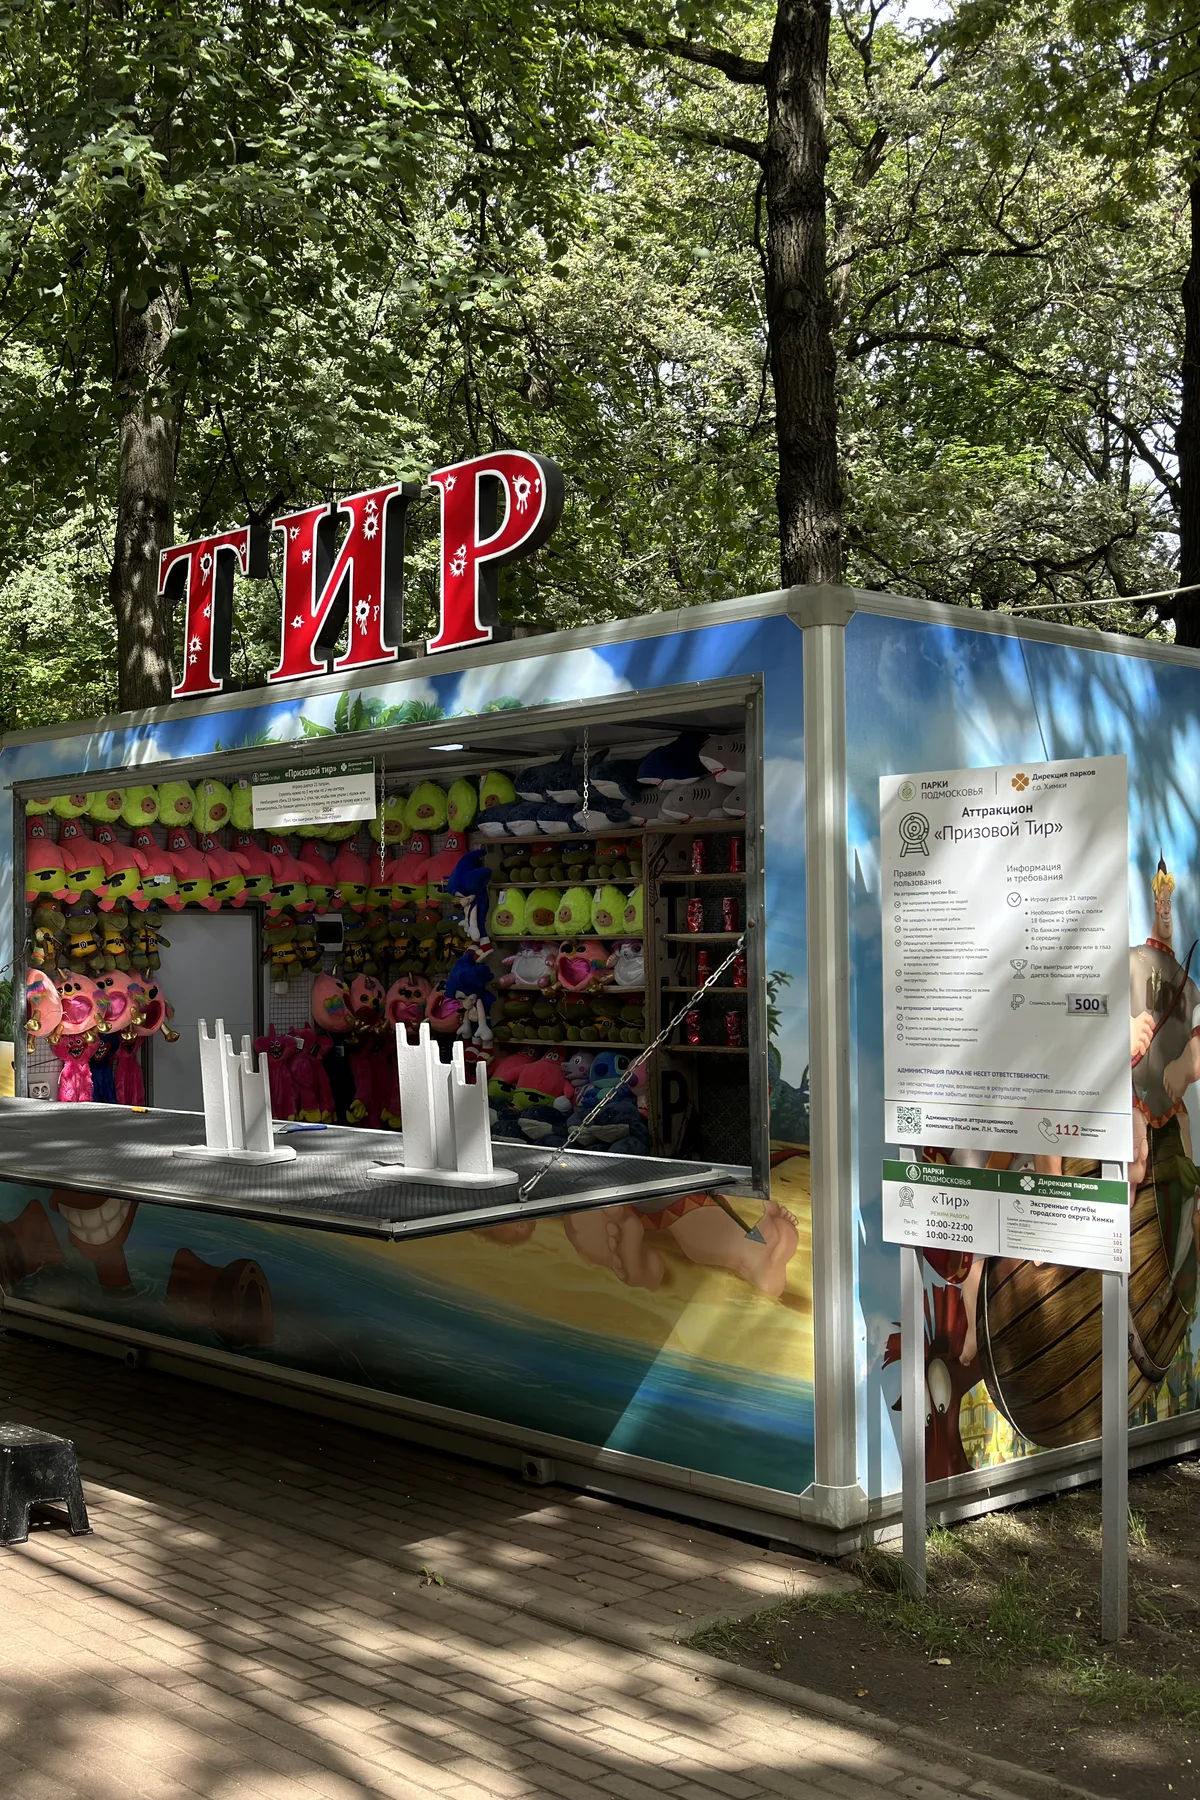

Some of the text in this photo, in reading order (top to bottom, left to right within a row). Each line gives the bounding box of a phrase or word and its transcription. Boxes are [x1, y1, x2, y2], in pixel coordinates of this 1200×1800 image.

[157, 449, 557, 698] ТИР
[285, 766, 320, 778] «Призовой
[322, 766, 336, 774] тир»
[1032, 770, 1095, 781] Дирекция парков
[921, 781, 948, 789] ПАРКИ
[921, 788, 983, 799] ПОДМОСКОВЬЯ
[962, 805, 1033, 819] Аттракцион
[934, 820, 1063, 843] «Призовой Тир»
[894, 870, 925, 878] Правила
[1007, 864, 1061, 873] Информация
[894, 879, 941, 887] пользования
[1014, 874, 1063, 883] требования
[1075, 999, 1100, 1010] 500
[1056, 1124, 1079, 1136] 112
[923, 1175, 971, 1185] ПОДМОСКОВЬЯ
[1038, 1178, 1098, 1191] Дирекция парков
[932, 1193, 970, 1209] «Тир»
[1030, 1200, 1068, 1210] Экстренные
[1030, 1210, 1066, 1219] городского
[926, 1219, 973, 1231] 10:00-22:00
[926, 1231, 973, 1243] 10:00-22:00
